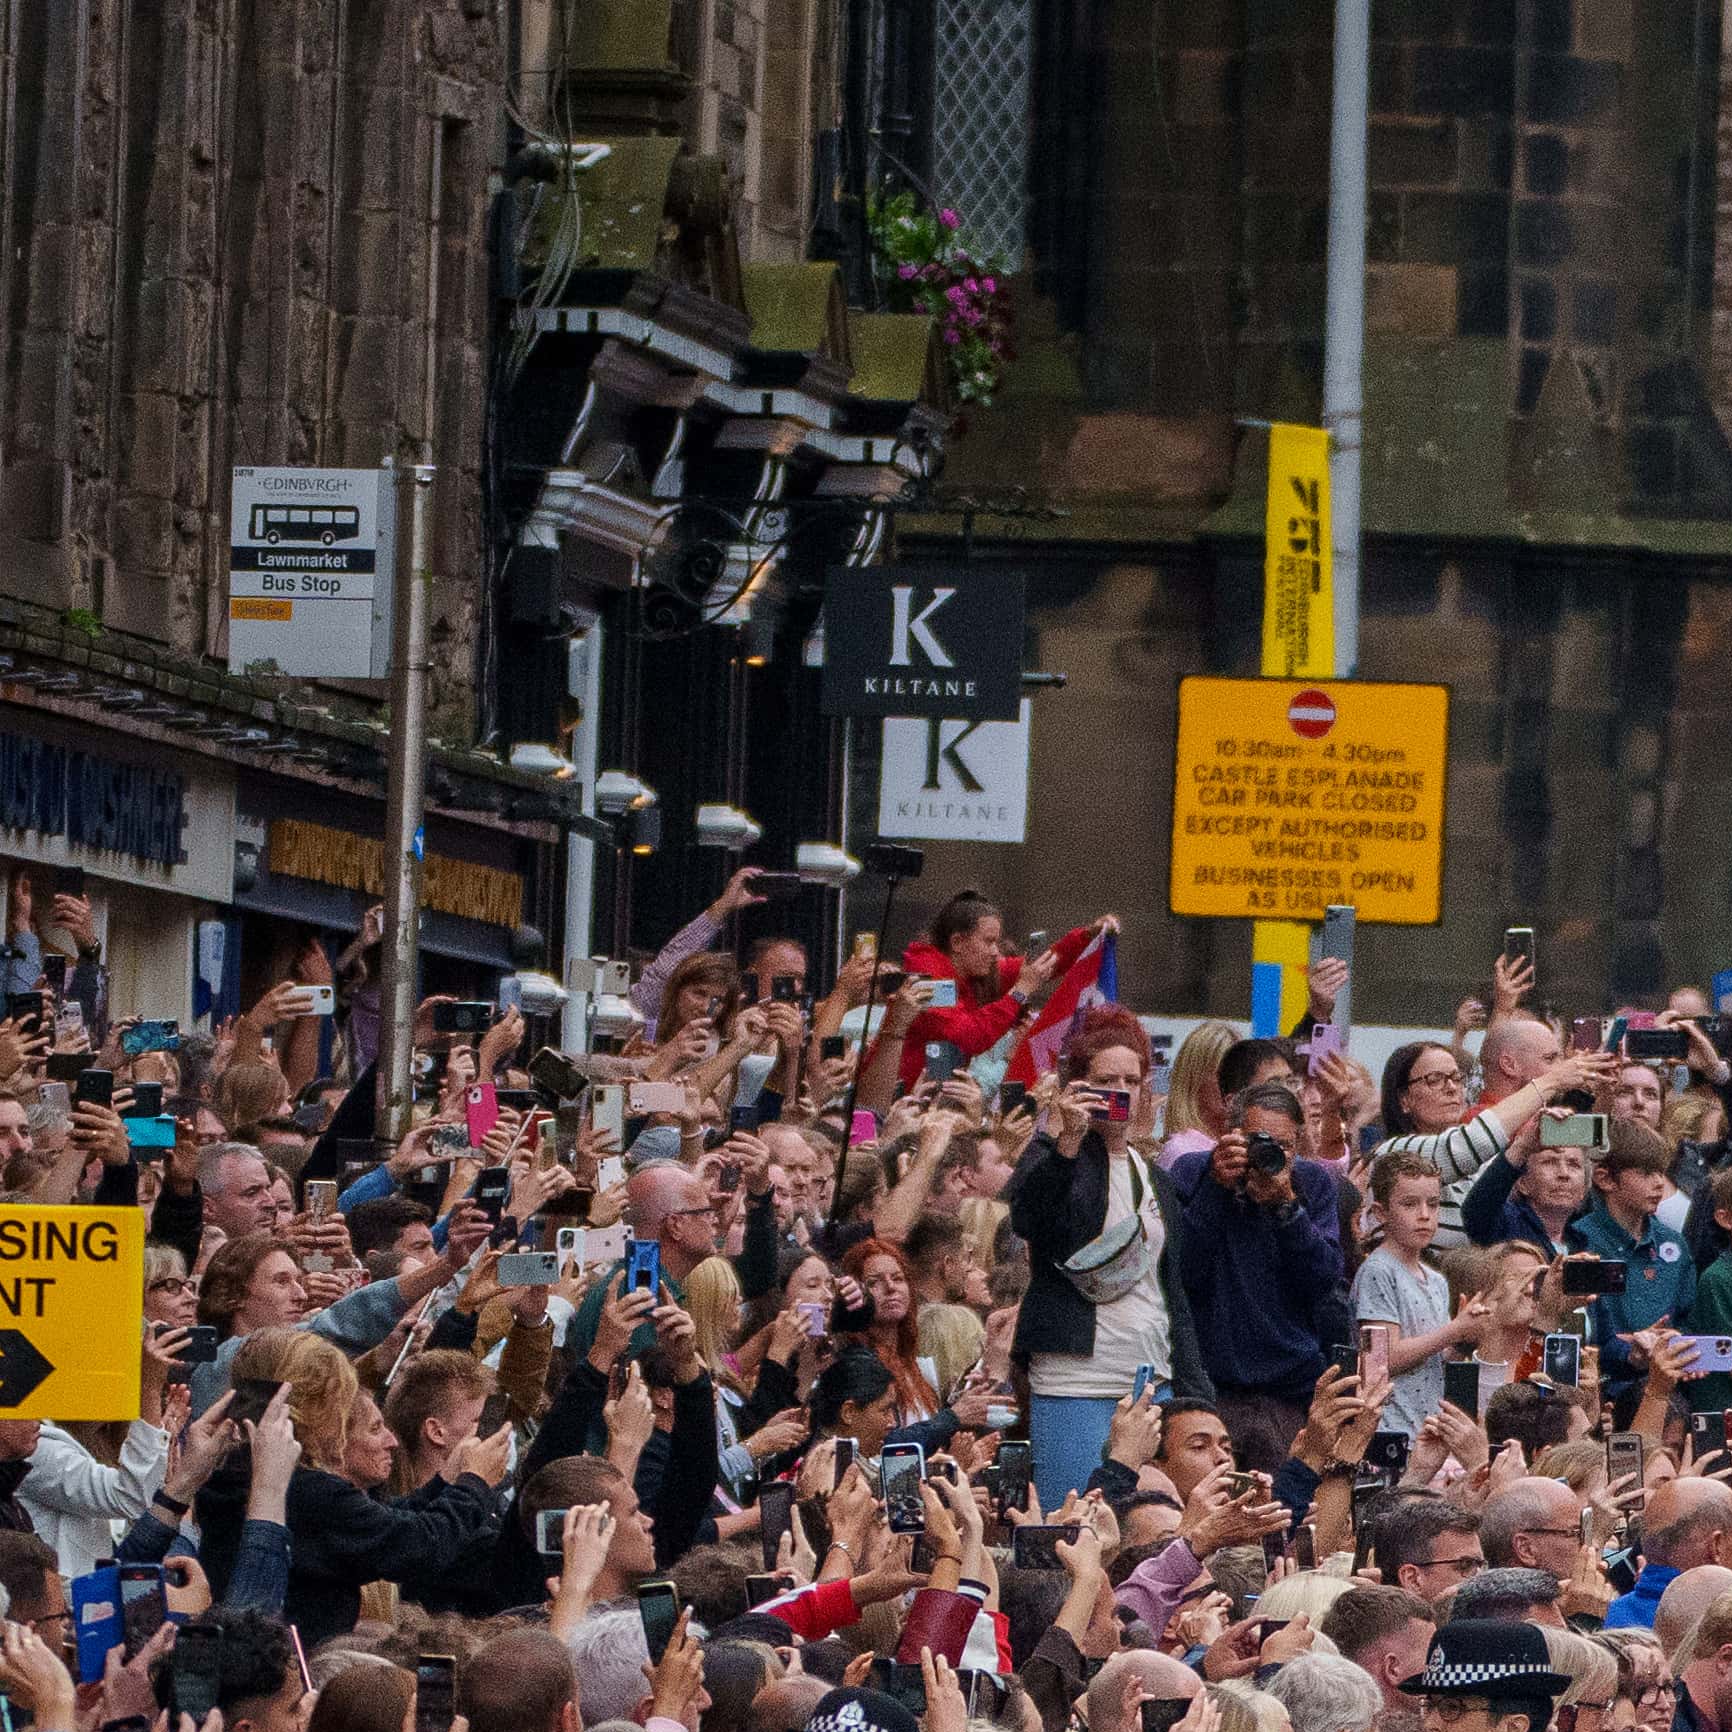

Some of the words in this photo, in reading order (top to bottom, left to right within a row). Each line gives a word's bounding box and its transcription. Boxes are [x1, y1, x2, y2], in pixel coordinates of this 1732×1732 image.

[257, 551, 348, 569] Lawnmarket
[262, 574, 295, 591] Bus
[301, 575, 341, 595] Stop
[889, 586, 957, 667] K
[864, 677, 977, 697] KILTANE
[921, 719, 985, 792] K
[1193, 764, 1279, 786] CASTLE
[1286, 767, 1426, 792] ESPLANADE
[897, 802, 1008, 821] KILTANE
[1197, 786, 1247, 807] CAR
[1255, 789, 1314, 809] PARK
[1321, 792, 1417, 813] CLOSED
[1184, 814, 1274, 836] EXCEPT
[1279, 818, 1428, 842] AUTHORISED
[1252, 840, 1361, 862] VEHICLES
[1193, 866, 1342, 889] BUSINESSES
[1351, 871, 1415, 893] OPEN
[1247, 890, 1277, 909] AS
[0, 1220, 119, 1262] SING
